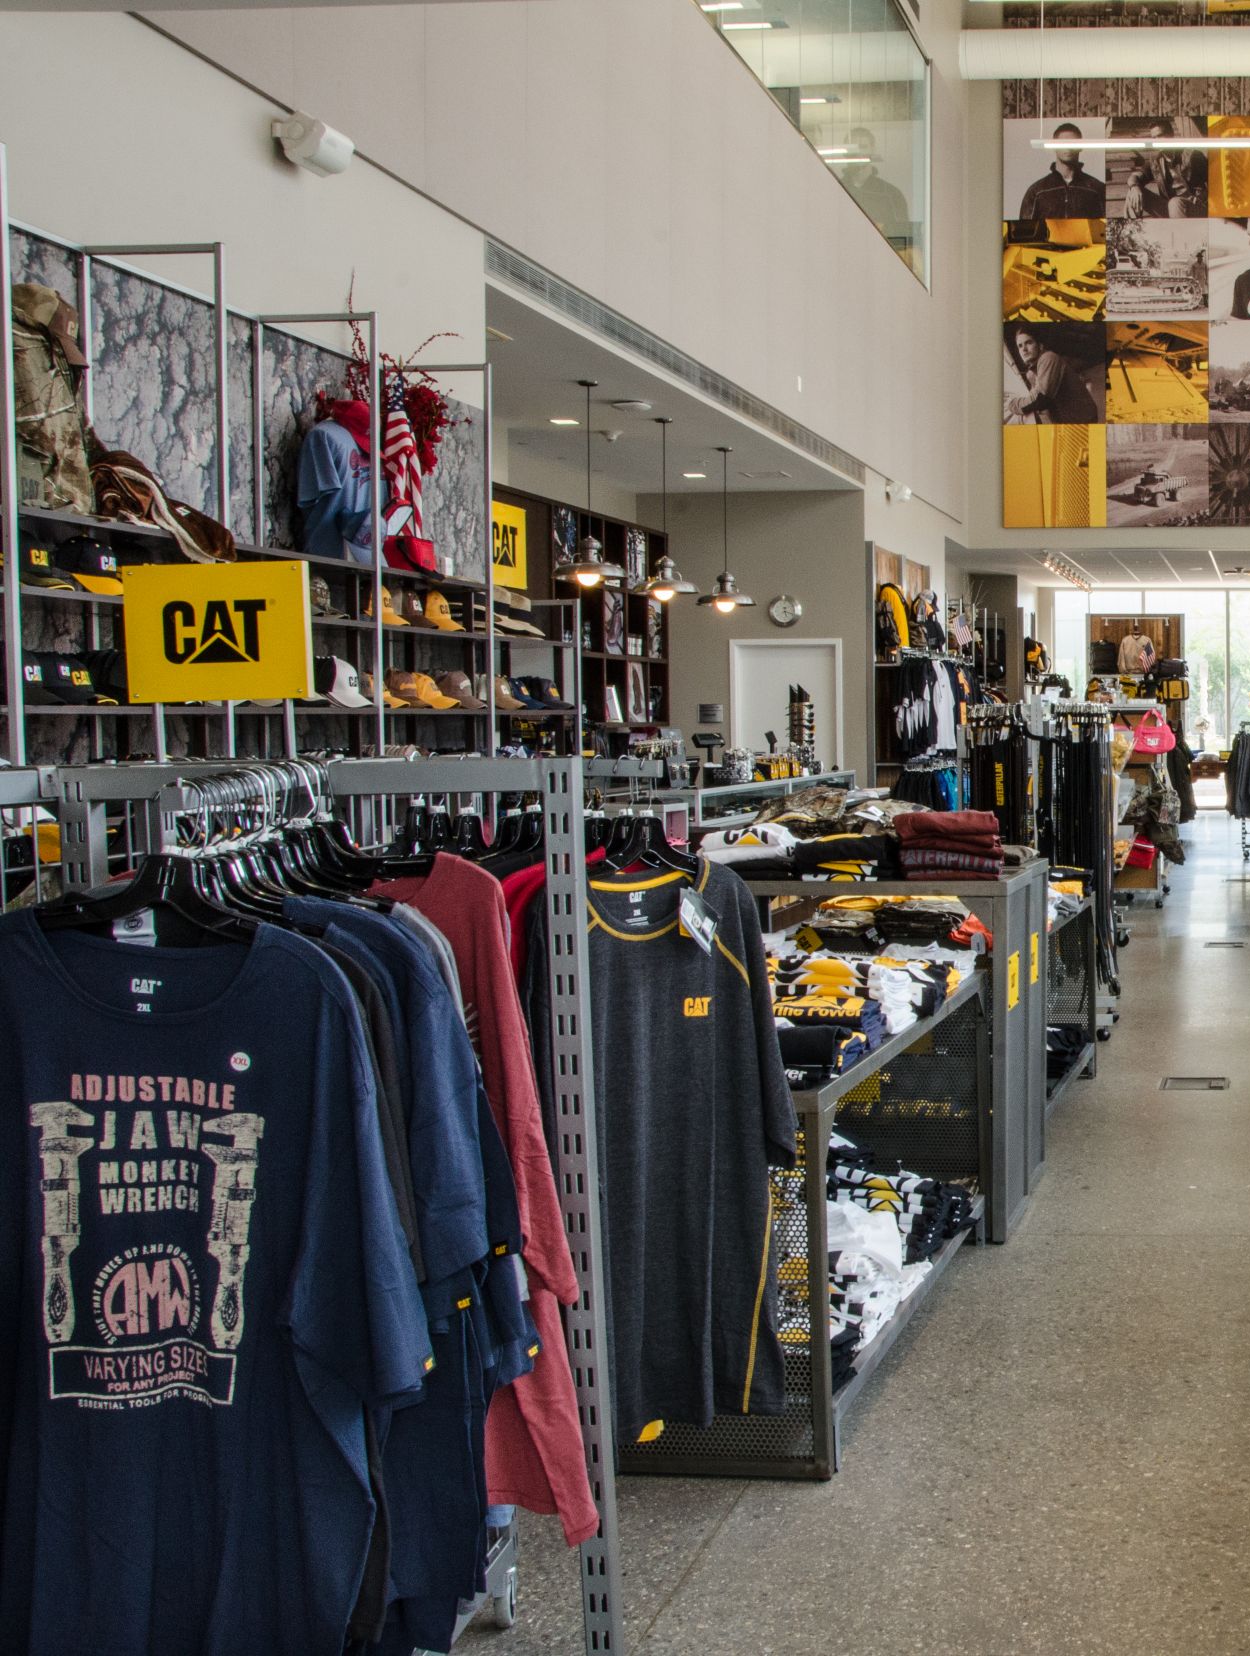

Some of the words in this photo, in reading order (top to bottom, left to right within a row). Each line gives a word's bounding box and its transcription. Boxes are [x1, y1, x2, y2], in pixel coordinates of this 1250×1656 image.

[162, 598, 267, 665] CAT
[629, 891, 646, 903] CAT
[131, 978, 162, 994] CAT
[137, 1003, 151, 1012] 2XL
[684, 997, 712, 1017] CAT
[233, 1056, 248, 1066] XXL
[71, 1074, 235, 1110] ADJUSTABLE
[100, 1110, 200, 1150] JAW
[100, 1159, 199, 1184] MONKEY
[101, 1185, 199, 1214] WRENCH
[495, 1245, 508, 1256] CAT
[94, 1255, 123, 1288] MOVES
[124, 1246, 139, 1260] UP
[142, 1243, 165, 1256] AND
[103, 1257, 191, 1336] AMW
[457, 1297, 472, 1310] CAT
[83, 1353, 166, 1380] VARYING
[108, 1381, 131, 1393] FOR
[133, 1379, 154, 1391] ANY
[157, 1373, 195, 1386] PROJECT
[78, 1399, 124, 1410] ESSENTIAL
[128, 1395, 161, 1408] TOOLS
[163, 1389, 179, 1400] FOR
